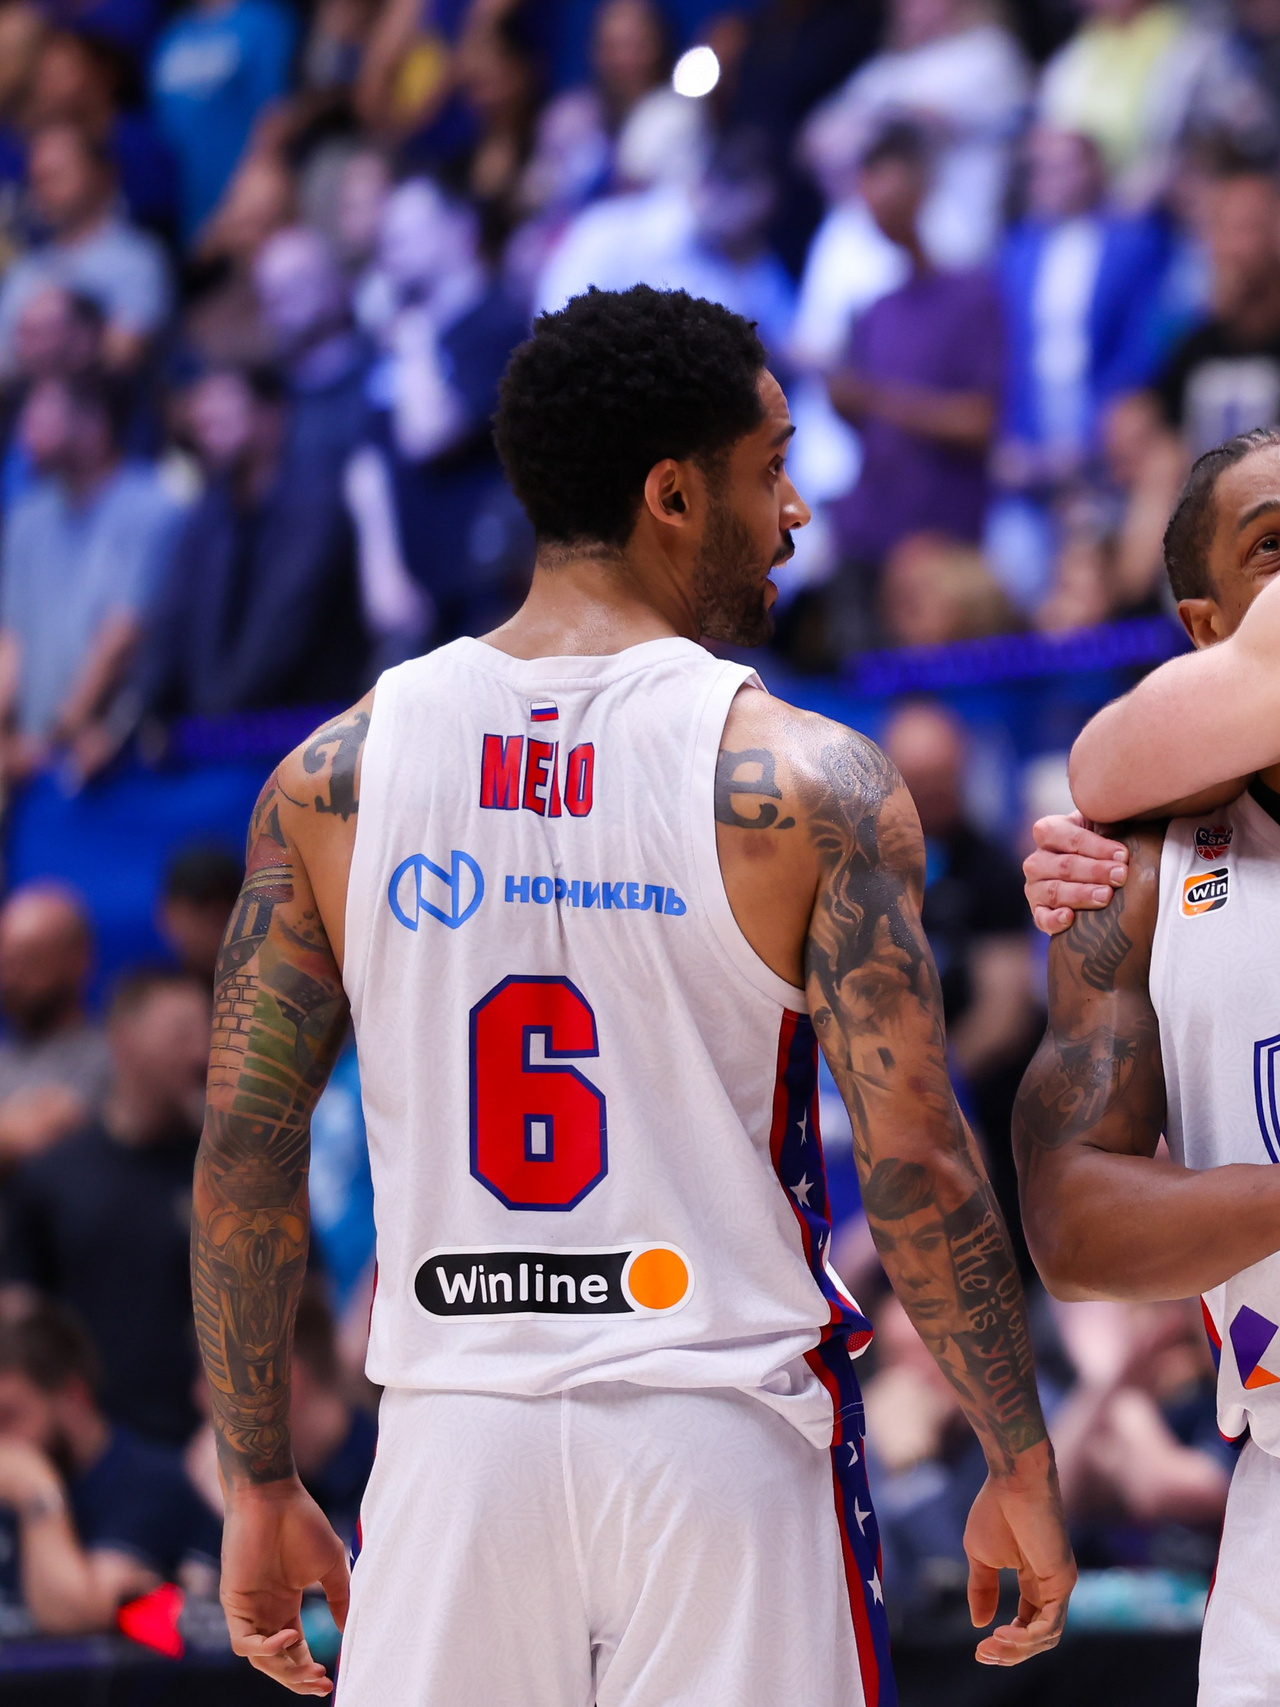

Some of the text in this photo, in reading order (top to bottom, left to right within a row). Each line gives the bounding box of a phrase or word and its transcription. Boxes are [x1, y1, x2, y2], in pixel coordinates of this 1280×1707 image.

[504, 875, 687, 916] НОРНИКЕЛЬ
[1192, 882, 1227, 901] Win
[469, 974, 609, 1212] 6
[435, 1262, 609, 1305] Winline
